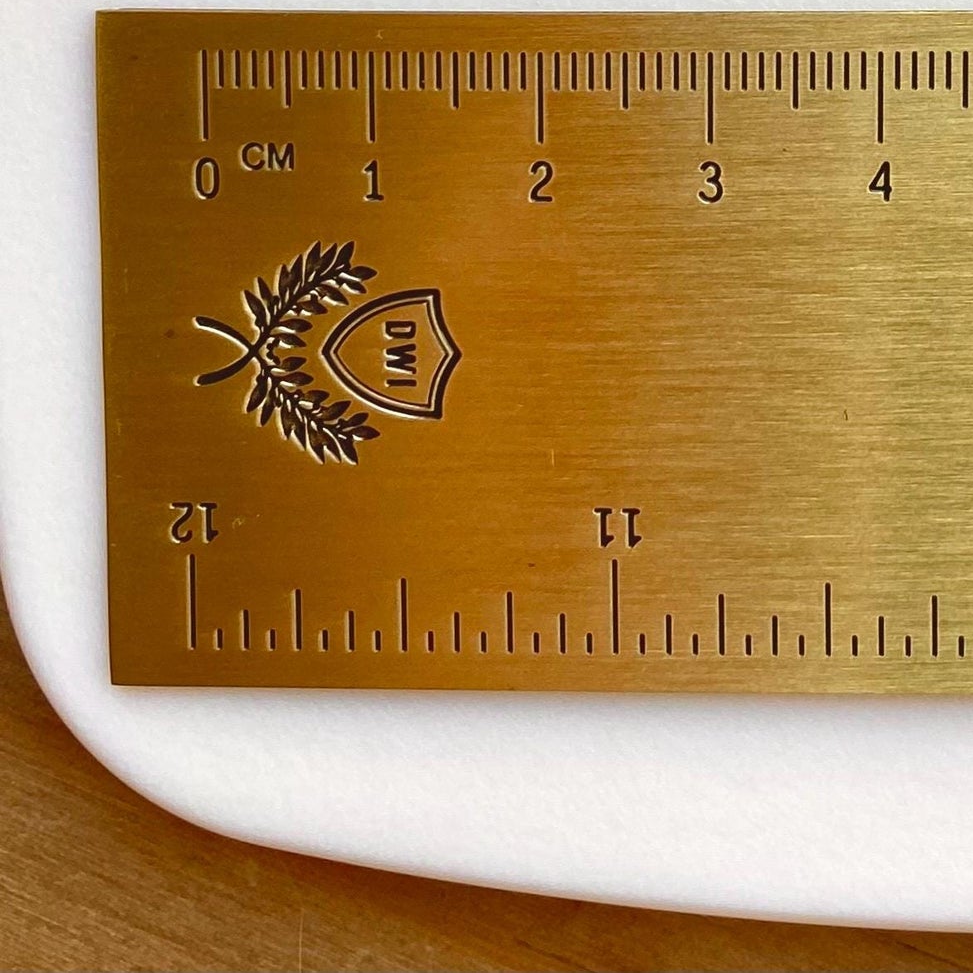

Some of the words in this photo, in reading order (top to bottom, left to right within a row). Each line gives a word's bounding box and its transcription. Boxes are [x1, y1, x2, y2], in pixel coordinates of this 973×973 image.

[195, 157, 220, 200] 0
[242, 142, 295, 171] CM
[364, 160, 384, 201] 1
[530, 160, 553, 203] 2
[698, 160, 724, 203] 3
[868, 161, 893, 202] 4
[385, 320, 417, 387] DWI
[171, 502, 219, 543] 12
[594, 507, 642, 548] 11
